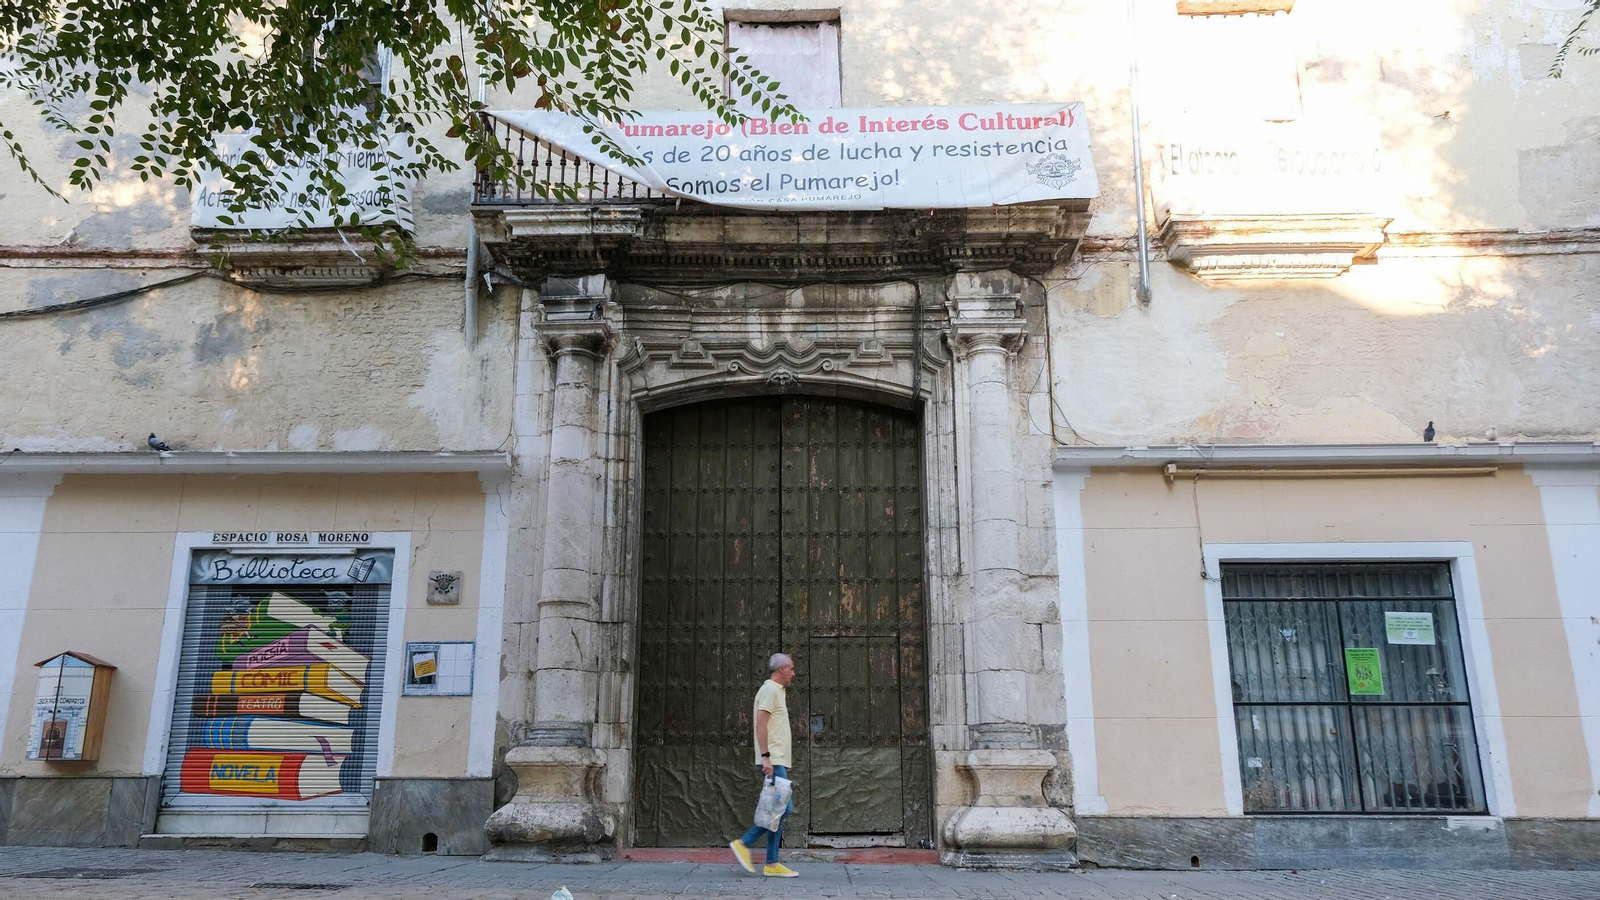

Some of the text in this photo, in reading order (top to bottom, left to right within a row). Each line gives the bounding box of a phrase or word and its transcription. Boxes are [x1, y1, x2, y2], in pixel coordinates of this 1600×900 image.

[741, 117, 809, 138] (Bien
[818, 116, 849, 134] de
[858, 113, 949, 133] Interés
[958, 109, 1074, 131] Cultural)
[663, 146, 691, 163] de
[701, 145, 731, 162] 20
[740, 145, 793, 162] años
[802, 144, 830, 161] de
[841, 142, 901, 160] lucha
[909, 145, 923, 161] y
[933, 137, 1068, 157] resistencia
[667, 169, 899, 195] Somos el Pumarejo!
[212, 533, 369, 542] ESPACIO ROSA MORENO
[212, 557, 338, 581] Biblioteca
[241, 697, 282, 710] TEATRO
[211, 763, 277, 783] NOVELA
